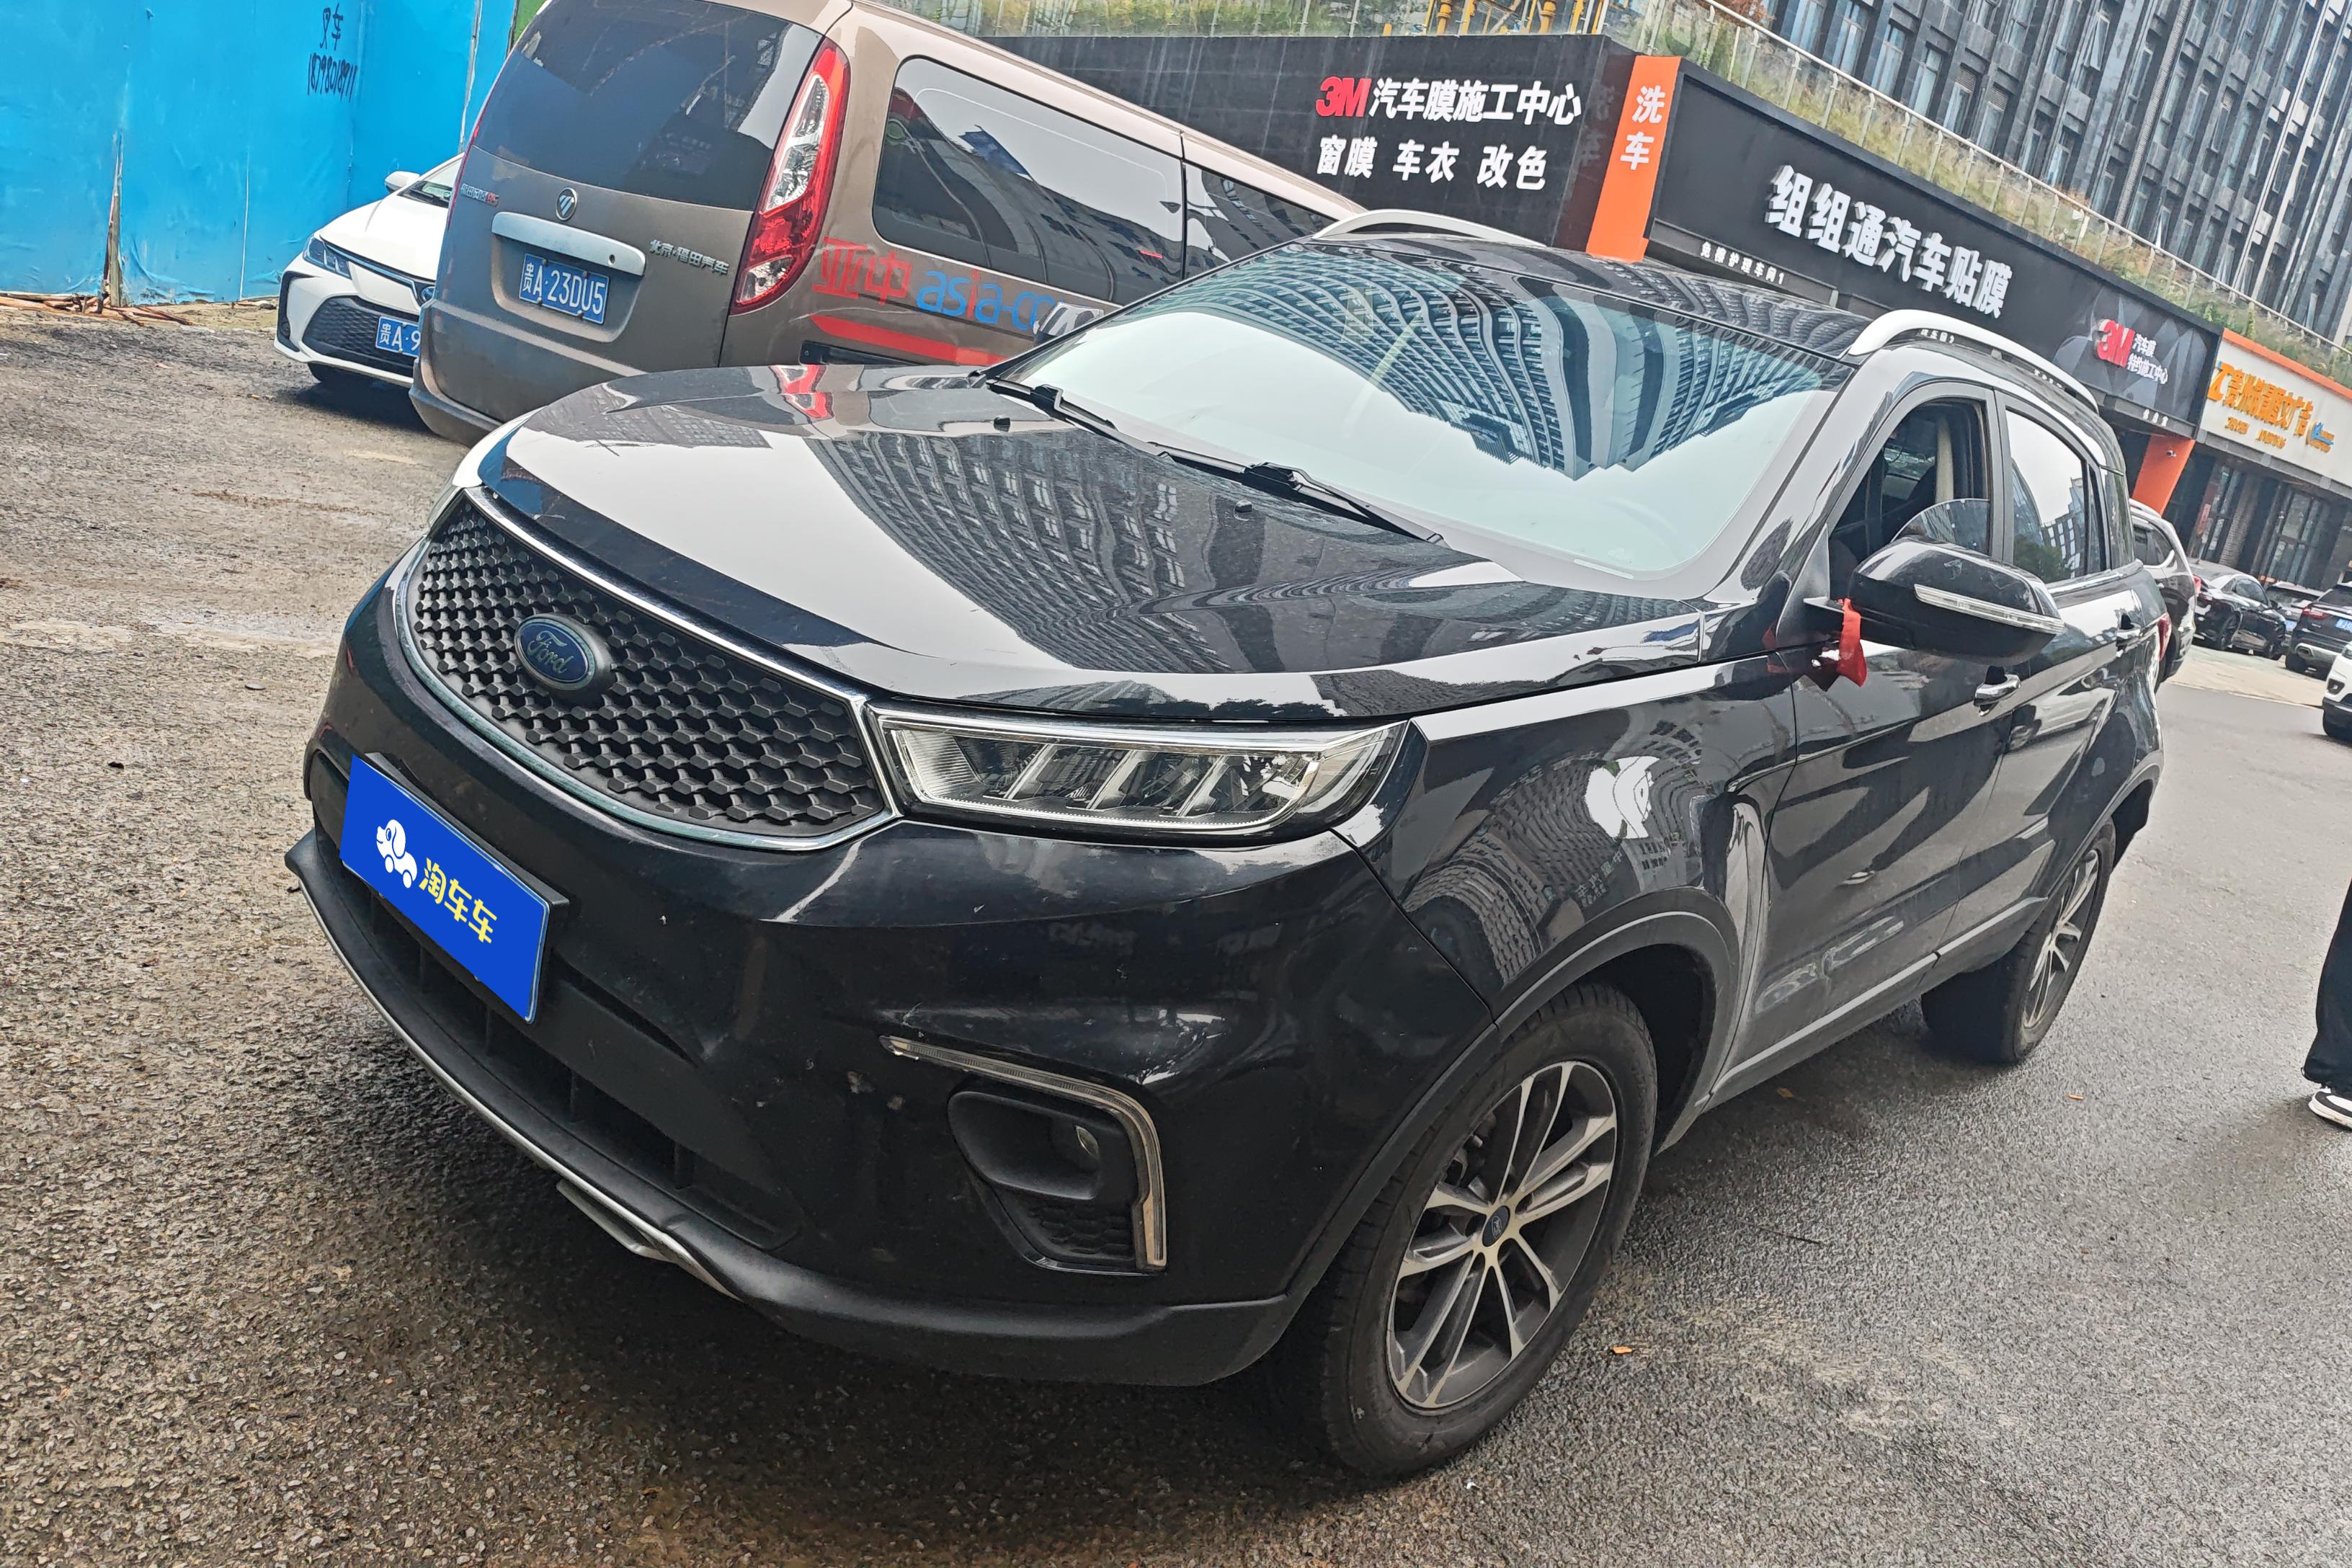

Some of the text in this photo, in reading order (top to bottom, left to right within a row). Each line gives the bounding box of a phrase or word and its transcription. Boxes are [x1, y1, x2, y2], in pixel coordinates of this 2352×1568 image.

[1315, 76, 1582, 125] 3M 汽车膜施工中心
[1620, 85, 1666, 171] 洗车
[1317, 135, 1548, 190] 窗膜 车衣 改色
[1765, 164, 2013, 319] 组组通汽车贴膜
[812, 236, 912, 306] 亚中
[2097, 318, 2136, 368] 3M
[527, 630, 575, 674] Ford
